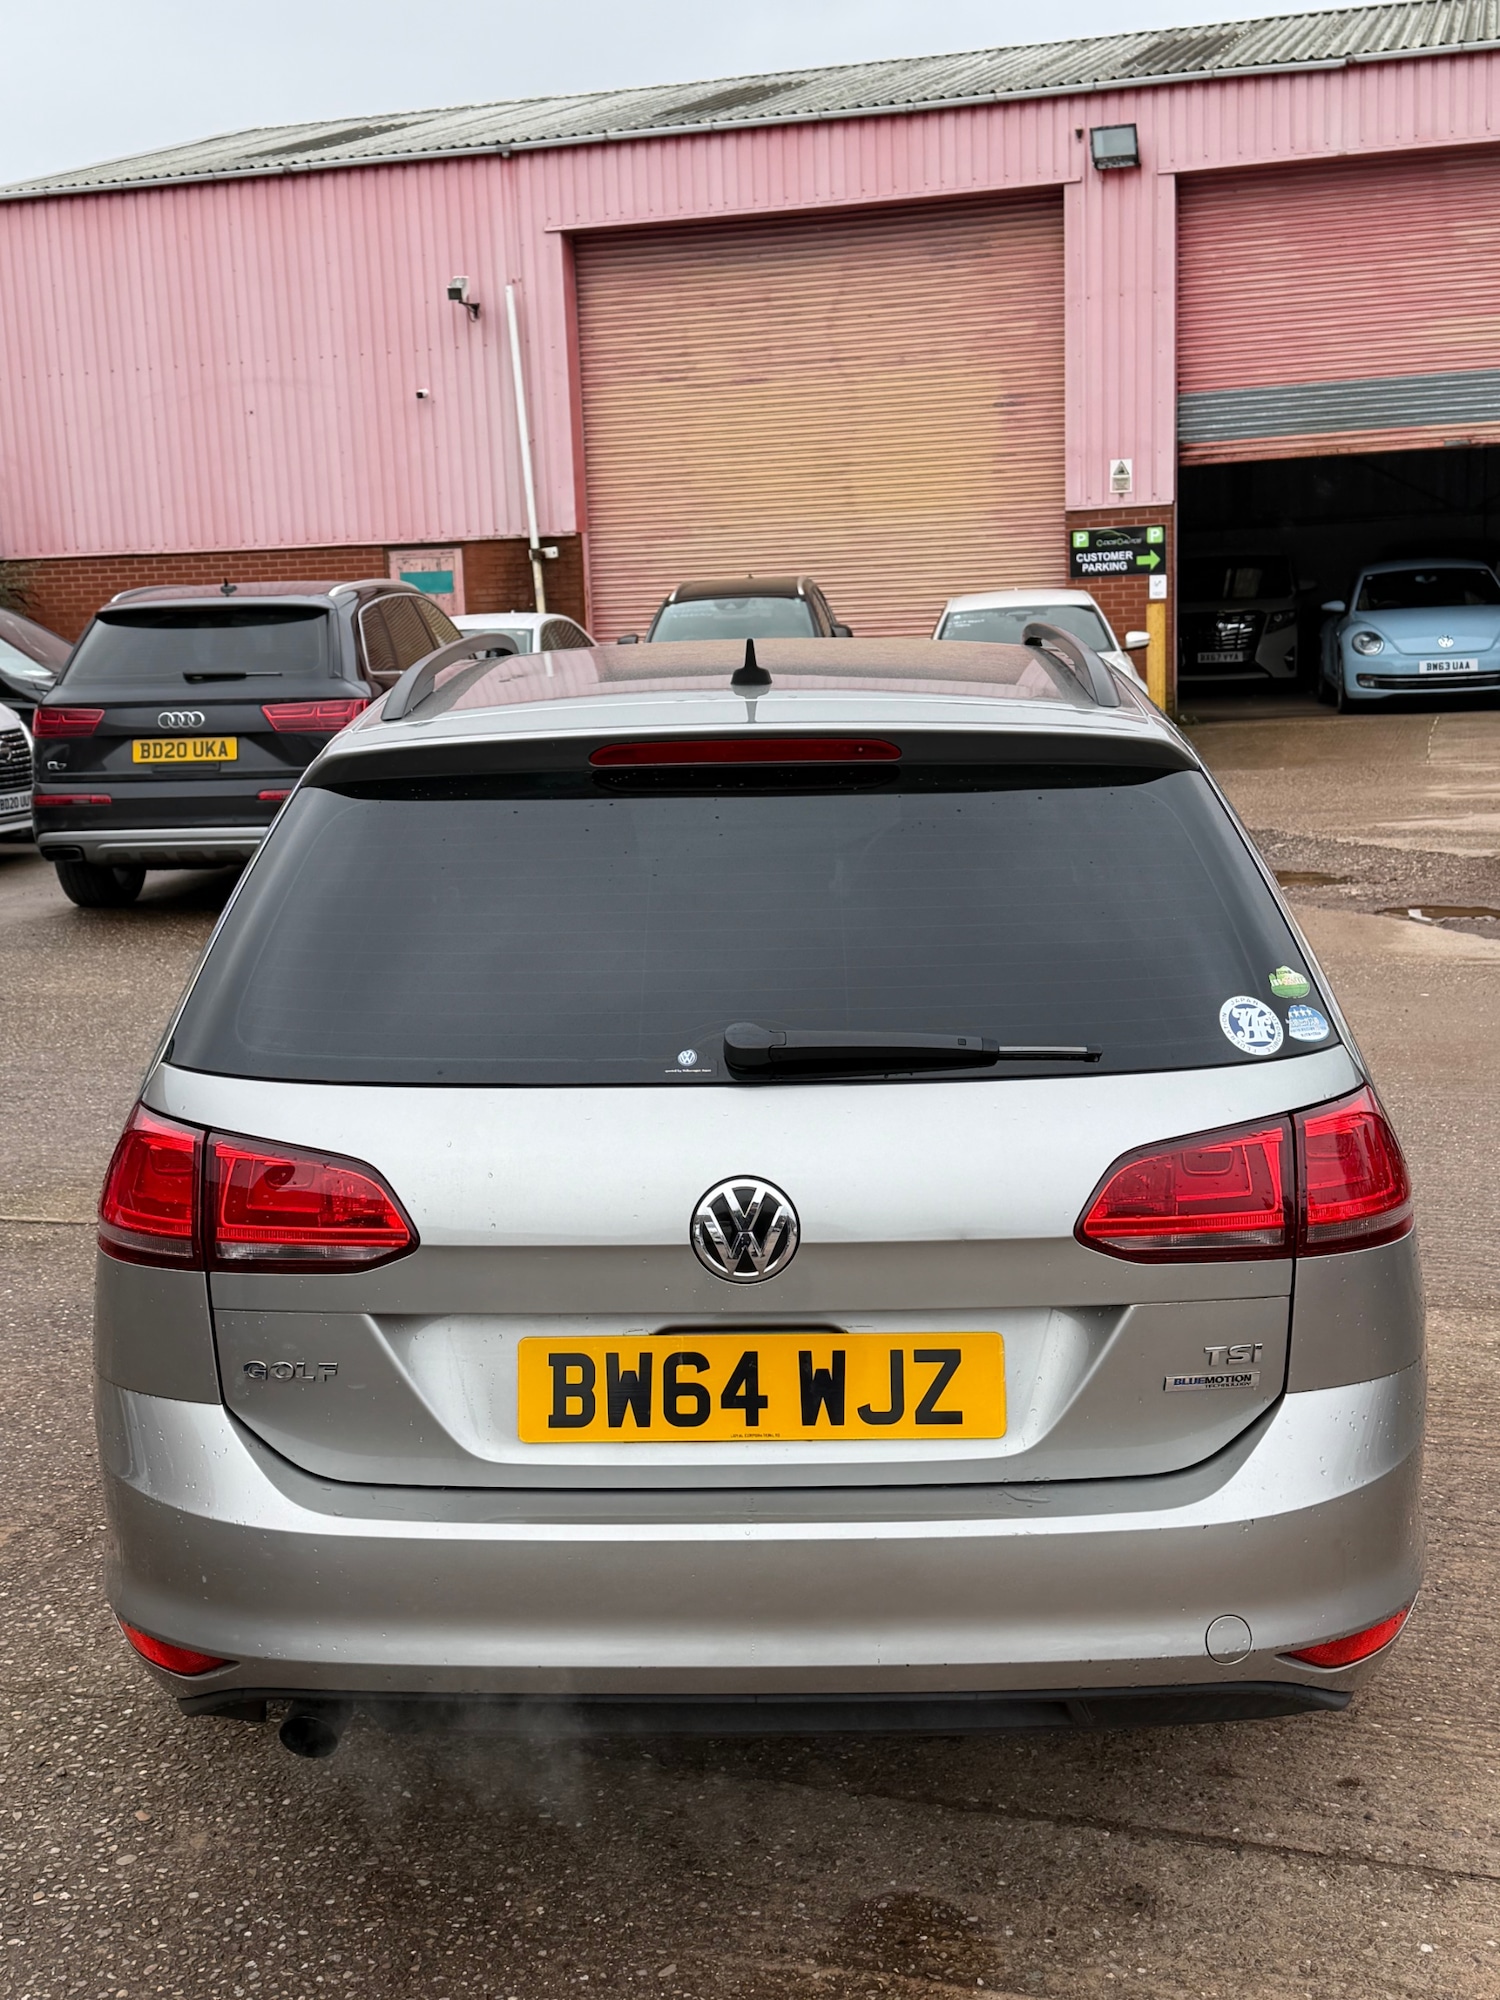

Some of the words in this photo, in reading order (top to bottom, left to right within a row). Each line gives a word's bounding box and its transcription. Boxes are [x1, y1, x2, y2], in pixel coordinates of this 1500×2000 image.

[1076, 532, 1086, 546] P
[1150, 528, 1161, 542] P
[1076, 550, 1134, 563] CUSTOMER
[1082, 561, 1128, 572] PARKING
[1452, 661, 1470, 670] UAA
[140, 742, 187, 759] BD20
[193, 741, 228, 757] UKA
[47, 761, 67, 770] Q7
[694, 1179, 797, 1280] VW
[1204, 1343, 1263, 1367] TSI
[243, 1360, 338, 1381] GOLF
[1173, 1374, 1252, 1386] BLUEMOTION
[548, 1350, 768, 1429] BW64
[798, 1348, 964, 1426] WJZ
